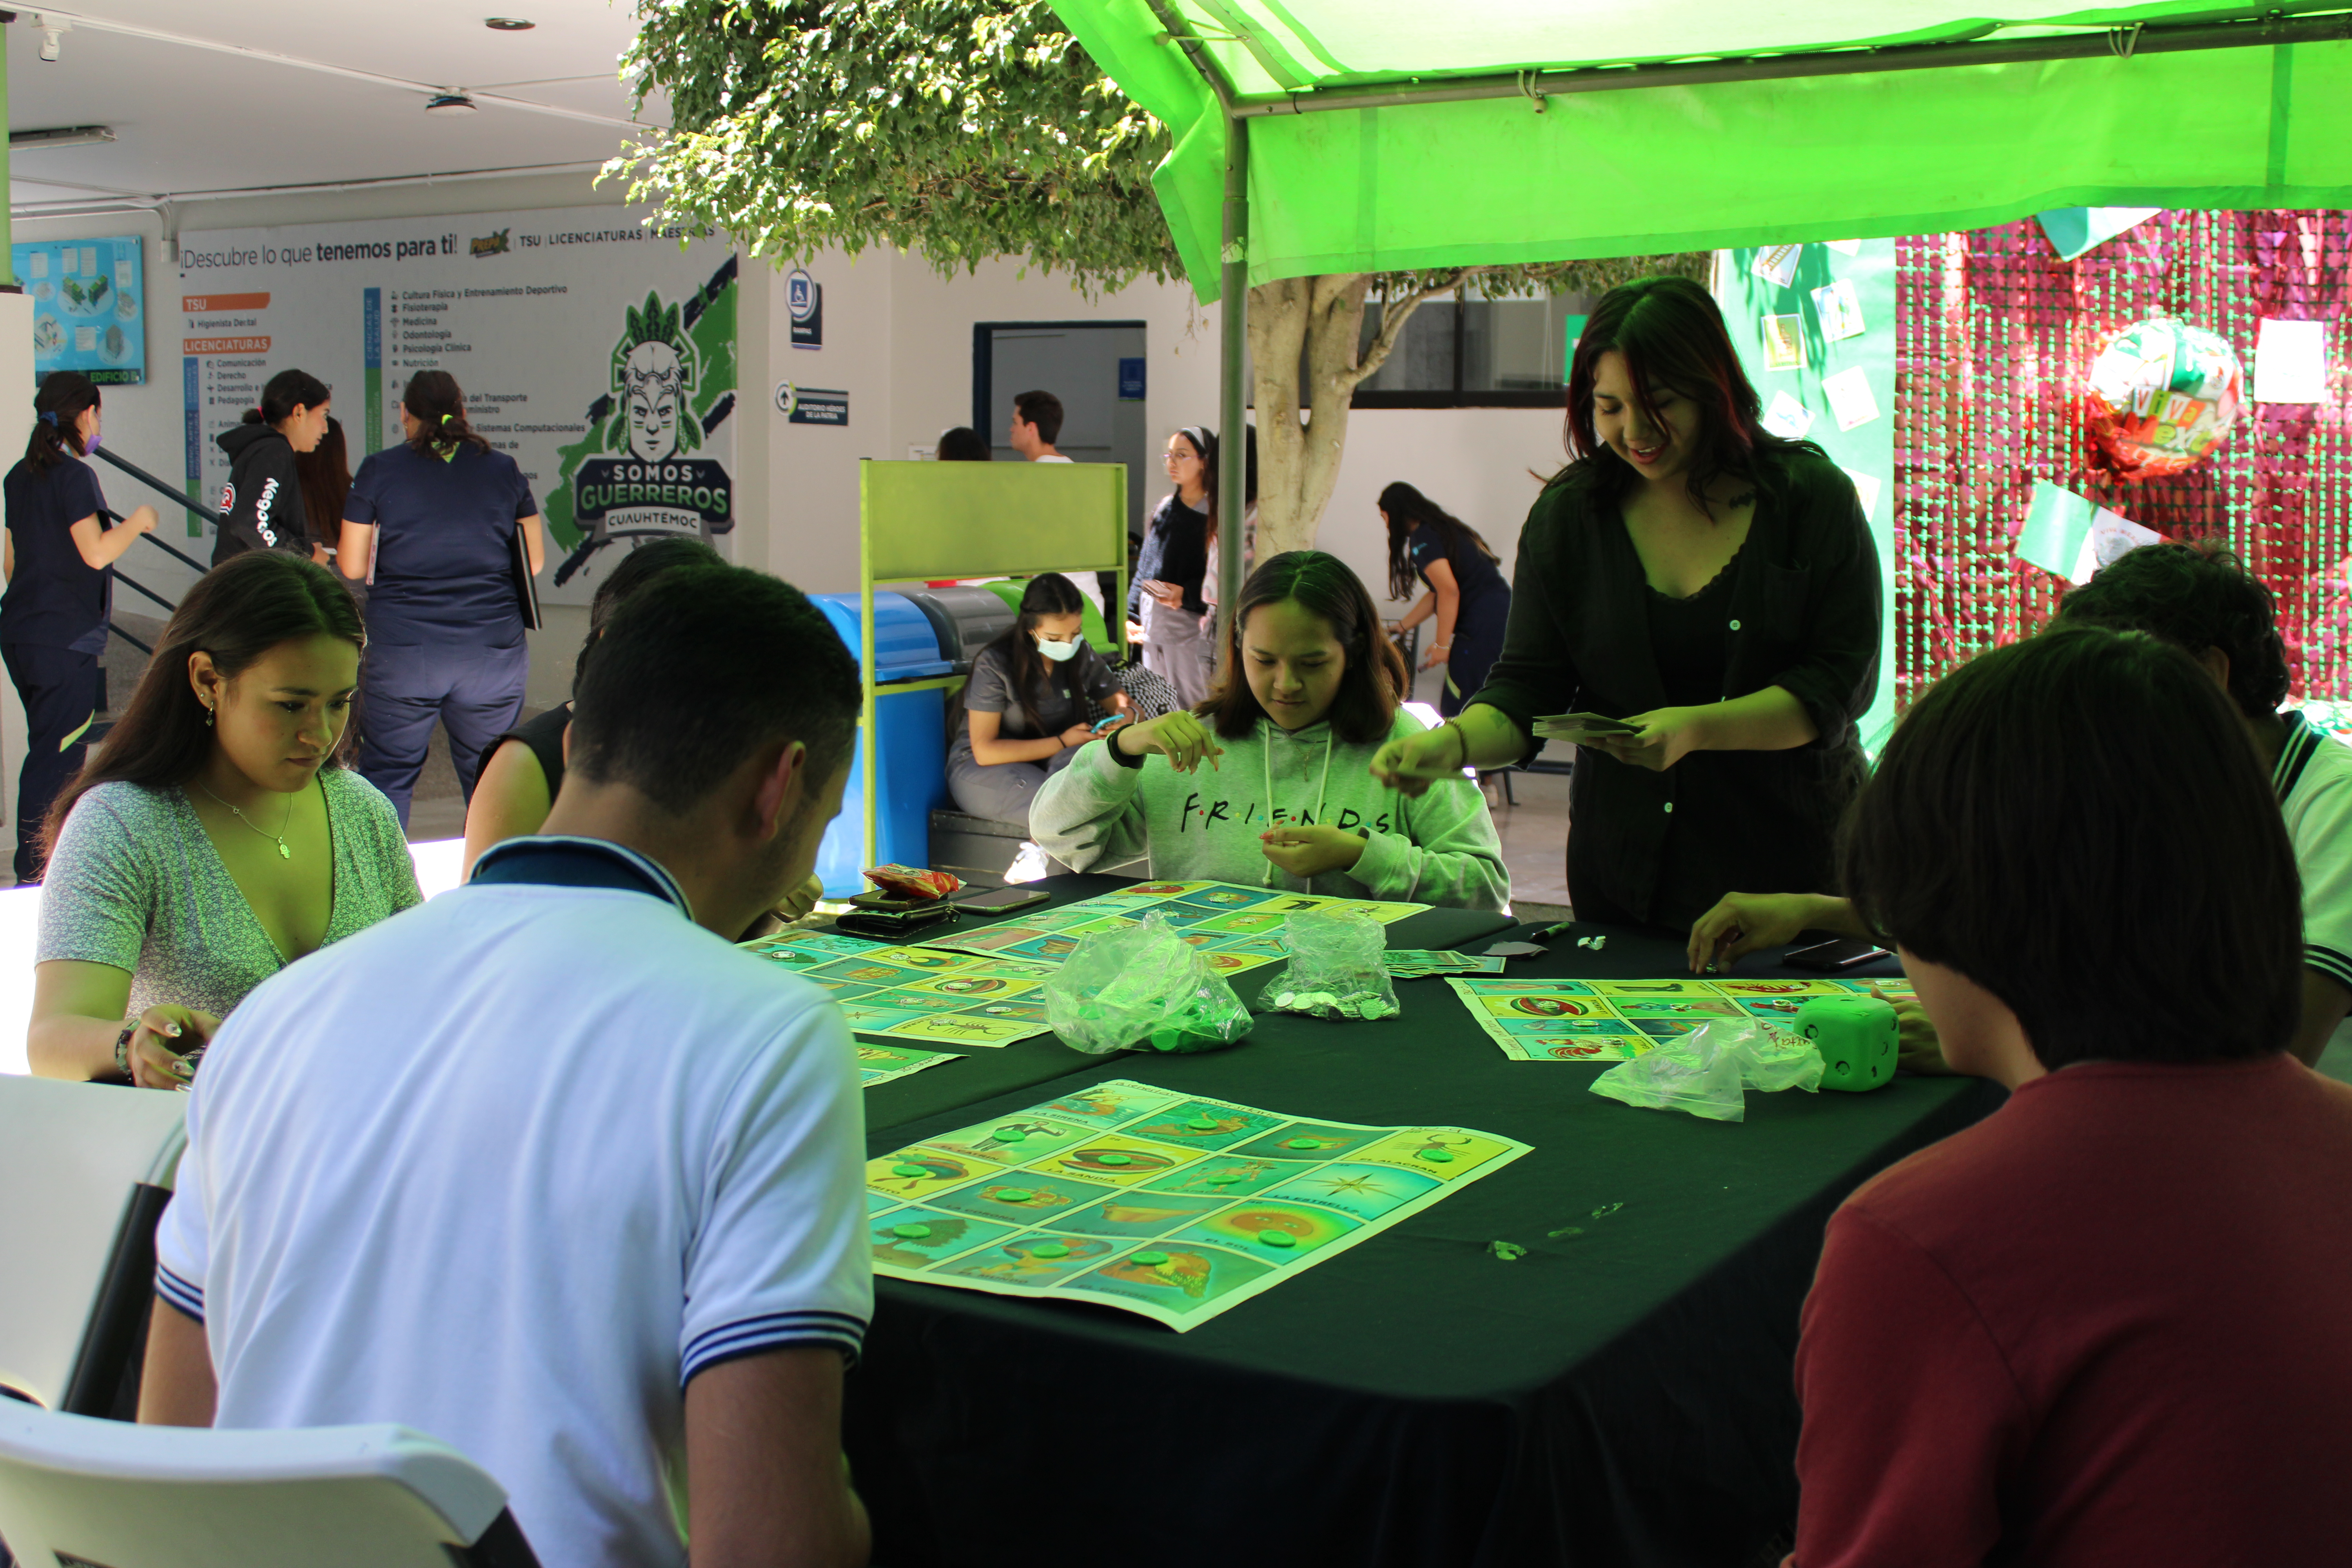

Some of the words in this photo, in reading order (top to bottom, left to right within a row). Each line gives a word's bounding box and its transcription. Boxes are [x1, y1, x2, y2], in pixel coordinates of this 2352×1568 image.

[519, 234, 541, 247] TSU
[549, 229, 643, 245] LICENCIATURAS
[650, 225, 715, 239] MAESRS
[180, 246, 258, 269] ¡Descubre
[262, 244, 277, 264] lo
[281, 247, 312, 267] que
[316, 242, 391, 261] tenemos
[396, 240, 436, 261] para
[441, 233, 458, 255] ti!
[402, 291, 431, 299] Cultura
[432, 289, 455, 298] Física
[457, 291, 462, 299] y
[464, 287, 524, 297] Entrenamiento
[526, 285, 568, 296] Deportivo
[186, 298, 207, 310] TSU
[366, 299, 373, 311] DE
[197, 319, 232, 329] Higienista
[403, 317, 437, 326] Medicina
[403, 329, 452, 340] Odontología
[185, 338, 268, 352] LICENCIATURAS
[403, 343, 443, 353] Psicología
[216, 358, 267, 367] Comunicación
[403, 358, 439, 367] Nutrición
[90, 371, 129, 382] EDIFICIO
[216, 383, 254, 392] Desarrollo
[217, 396, 255, 404] Pedagogía
[470, 394, 482, 402] del
[485, 393, 528, 403] Transporte
[465, 405, 500, 414] ministro
[476, 423, 512, 432] Sistemas
[514, 422, 585, 433] Computacionales
[508, 440, 519, 449] de
[613, 465, 693, 482] SOMOS
[580, 483, 727, 514] GUERREROS
[608, 511, 697, 529] CUAUHTÉMOC
[1634, 1038, 1650, 1049] GALLO
[1054, 1114, 1090, 1124] SIRENA
[960, 1149, 1000, 1161] CATRIN
[1377, 1159, 1438, 1174] ALACRAN
[1067, 1171, 1117, 1183] SANDIA
[1294, 1197, 1360, 1214] ESTRELLA
[1225, 1241, 1250, 1252] SOL
